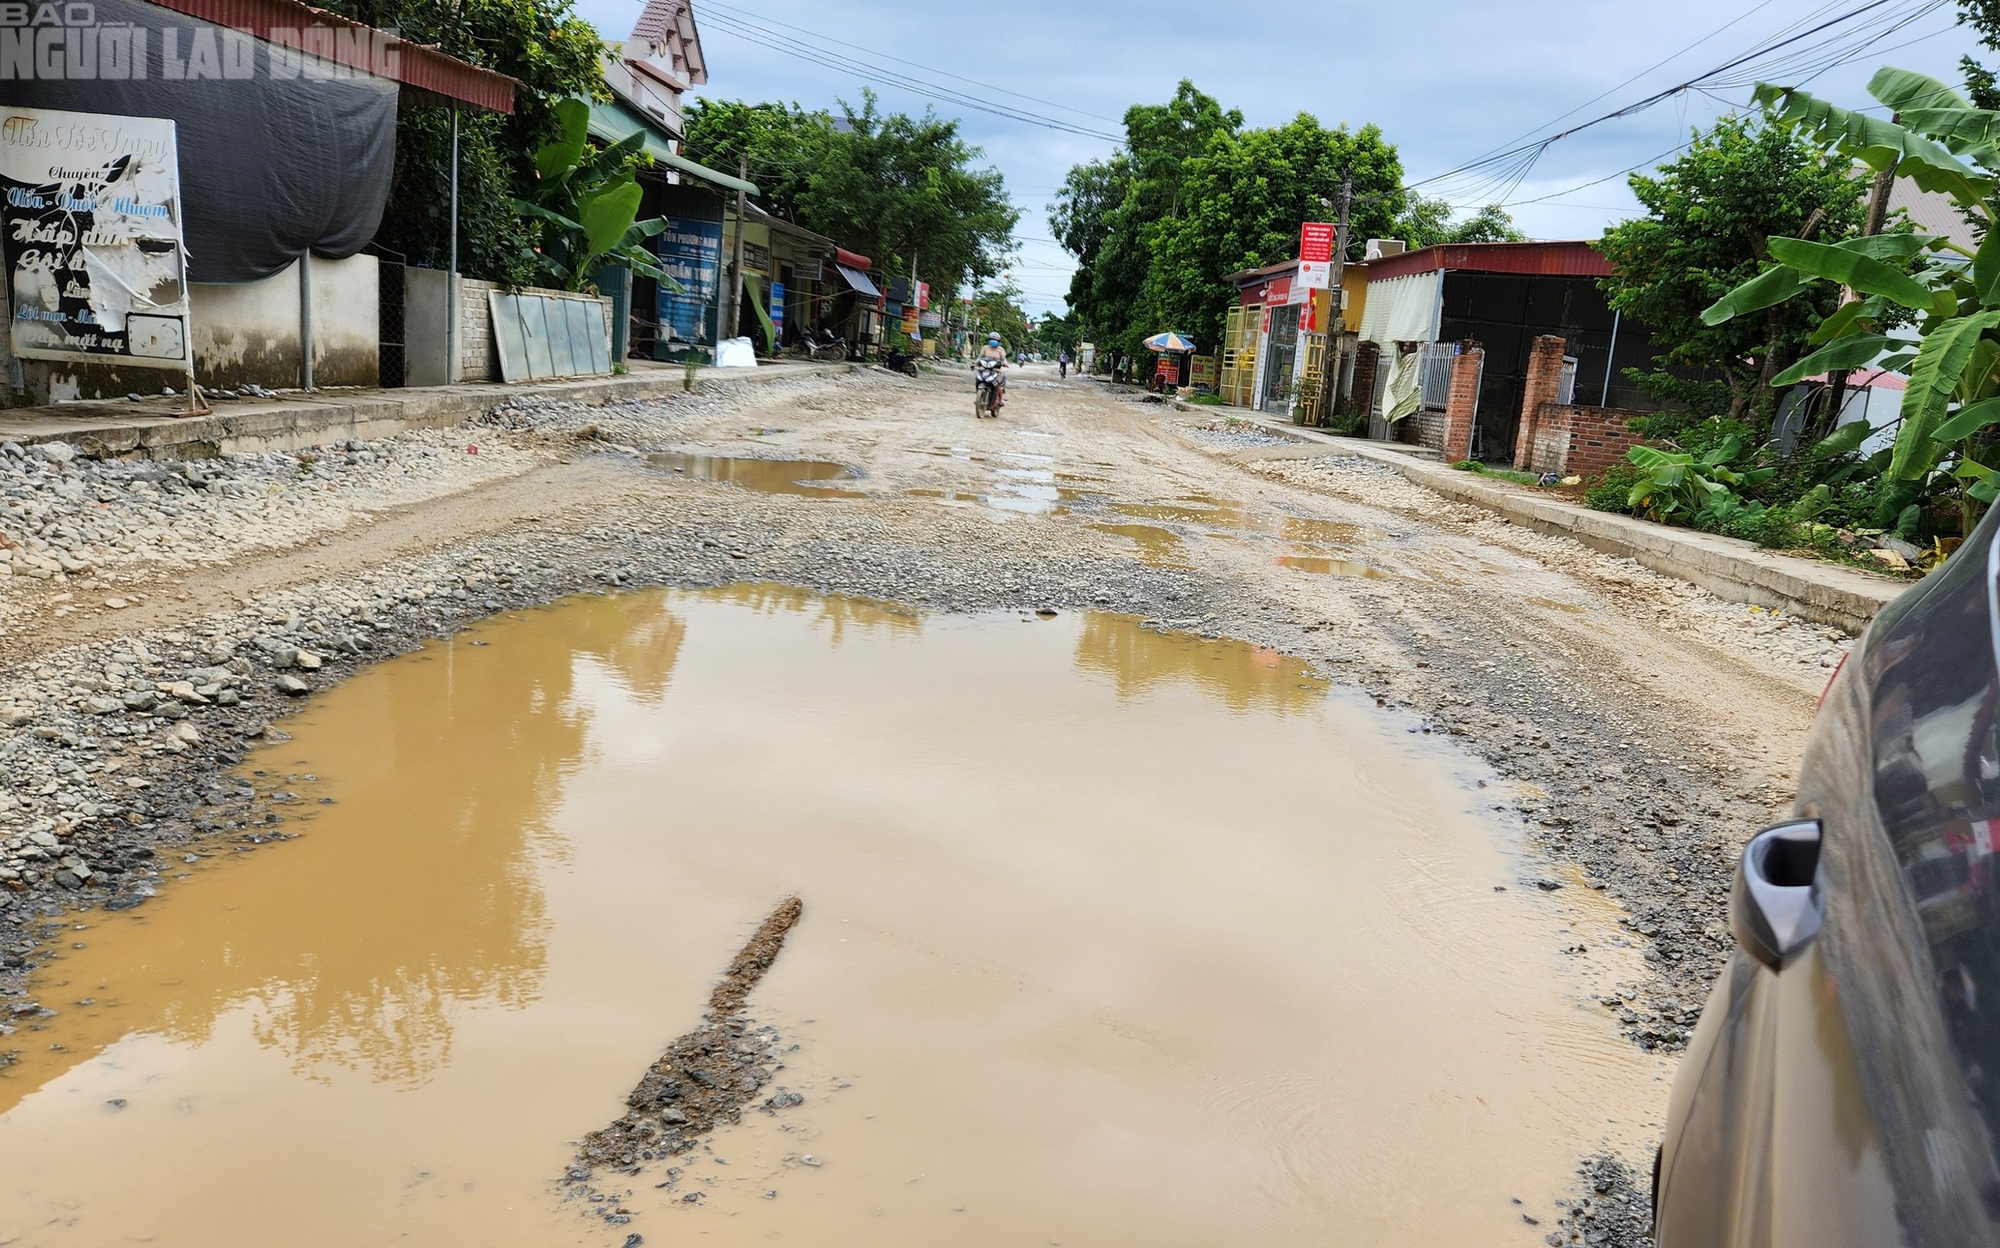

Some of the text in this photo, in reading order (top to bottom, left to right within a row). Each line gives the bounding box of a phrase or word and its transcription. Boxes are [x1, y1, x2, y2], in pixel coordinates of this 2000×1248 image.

[7, 187, 45, 209] Uốn
[109, 195, 169, 221] Nhuộm
[10, 217, 75, 249] Hấp
